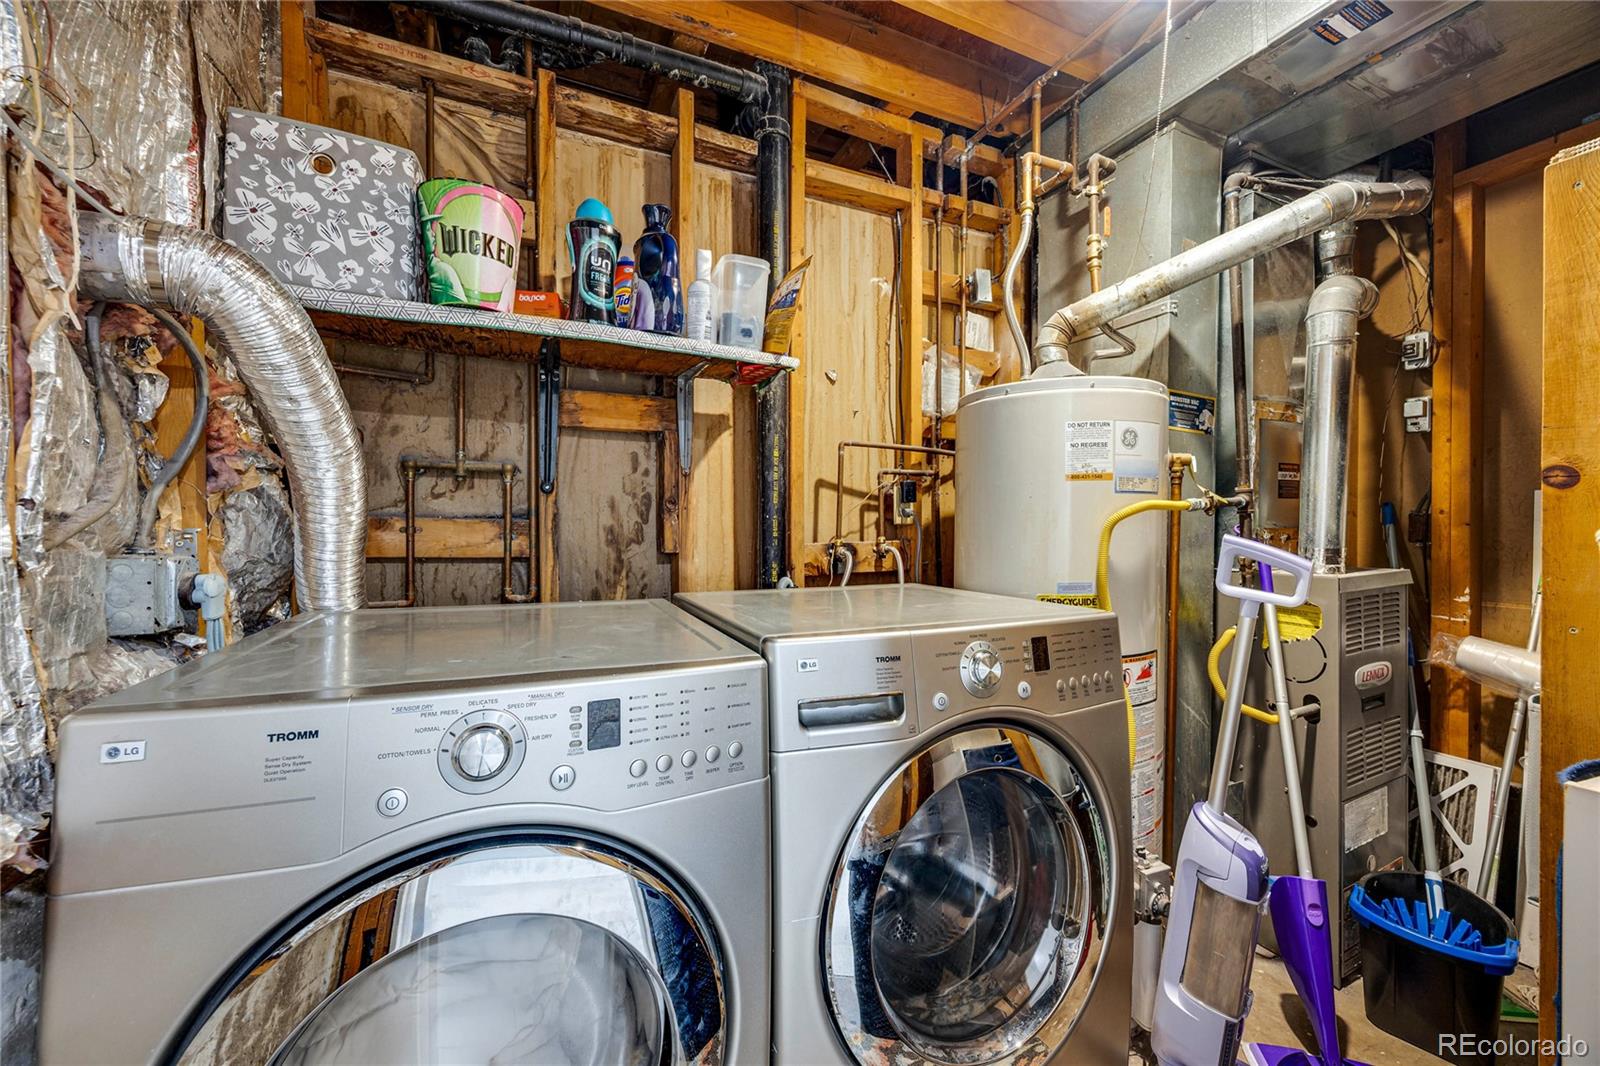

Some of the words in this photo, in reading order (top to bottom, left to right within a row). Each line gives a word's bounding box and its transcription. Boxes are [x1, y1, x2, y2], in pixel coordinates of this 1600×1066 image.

[438, 222, 514, 269] WICKED
[519, 293, 546, 302] bounce
[616, 294, 631, 308] Tid
[876, 655, 901, 663] TROMM
[1361, 667, 1385, 683] LENNOX
[468, 698, 499, 707] DELICATES
[395, 705, 420, 713] SENSOR
[414, 726, 441, 734] NORMAL
[267, 729, 319, 743] TROMM
[124, 747, 139, 756] LG
[377, 748, 431, 760] COTTON/TOWELS
